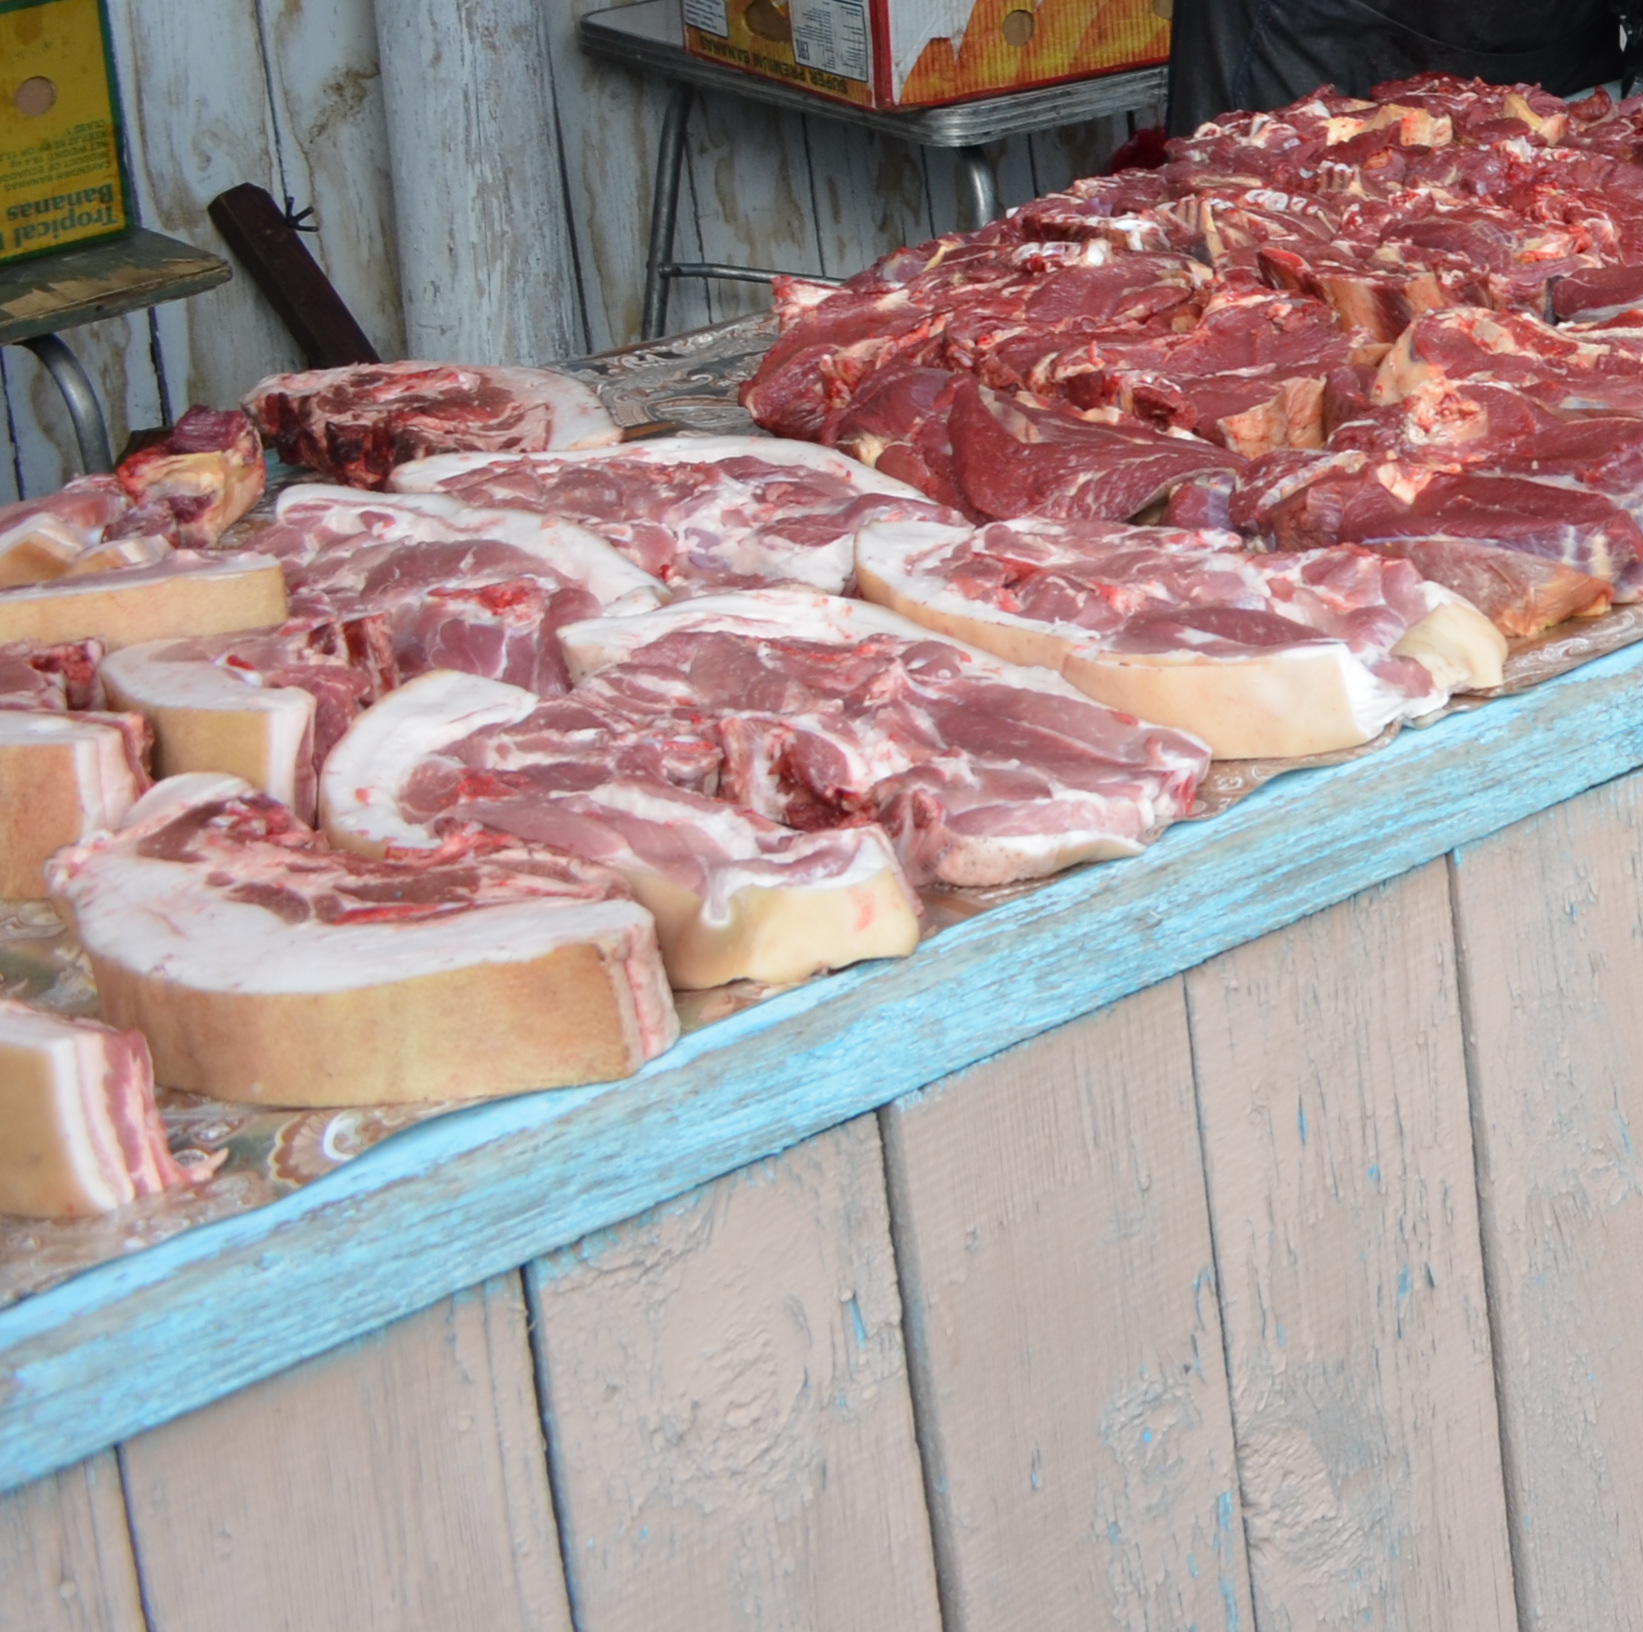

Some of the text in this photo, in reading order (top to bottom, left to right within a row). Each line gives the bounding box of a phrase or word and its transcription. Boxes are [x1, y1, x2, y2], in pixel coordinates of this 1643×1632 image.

[811, 71, 848, 95] SUPER
[6, 183, 114, 221] Bananas
[13, 205, 118, 249] Tropical
